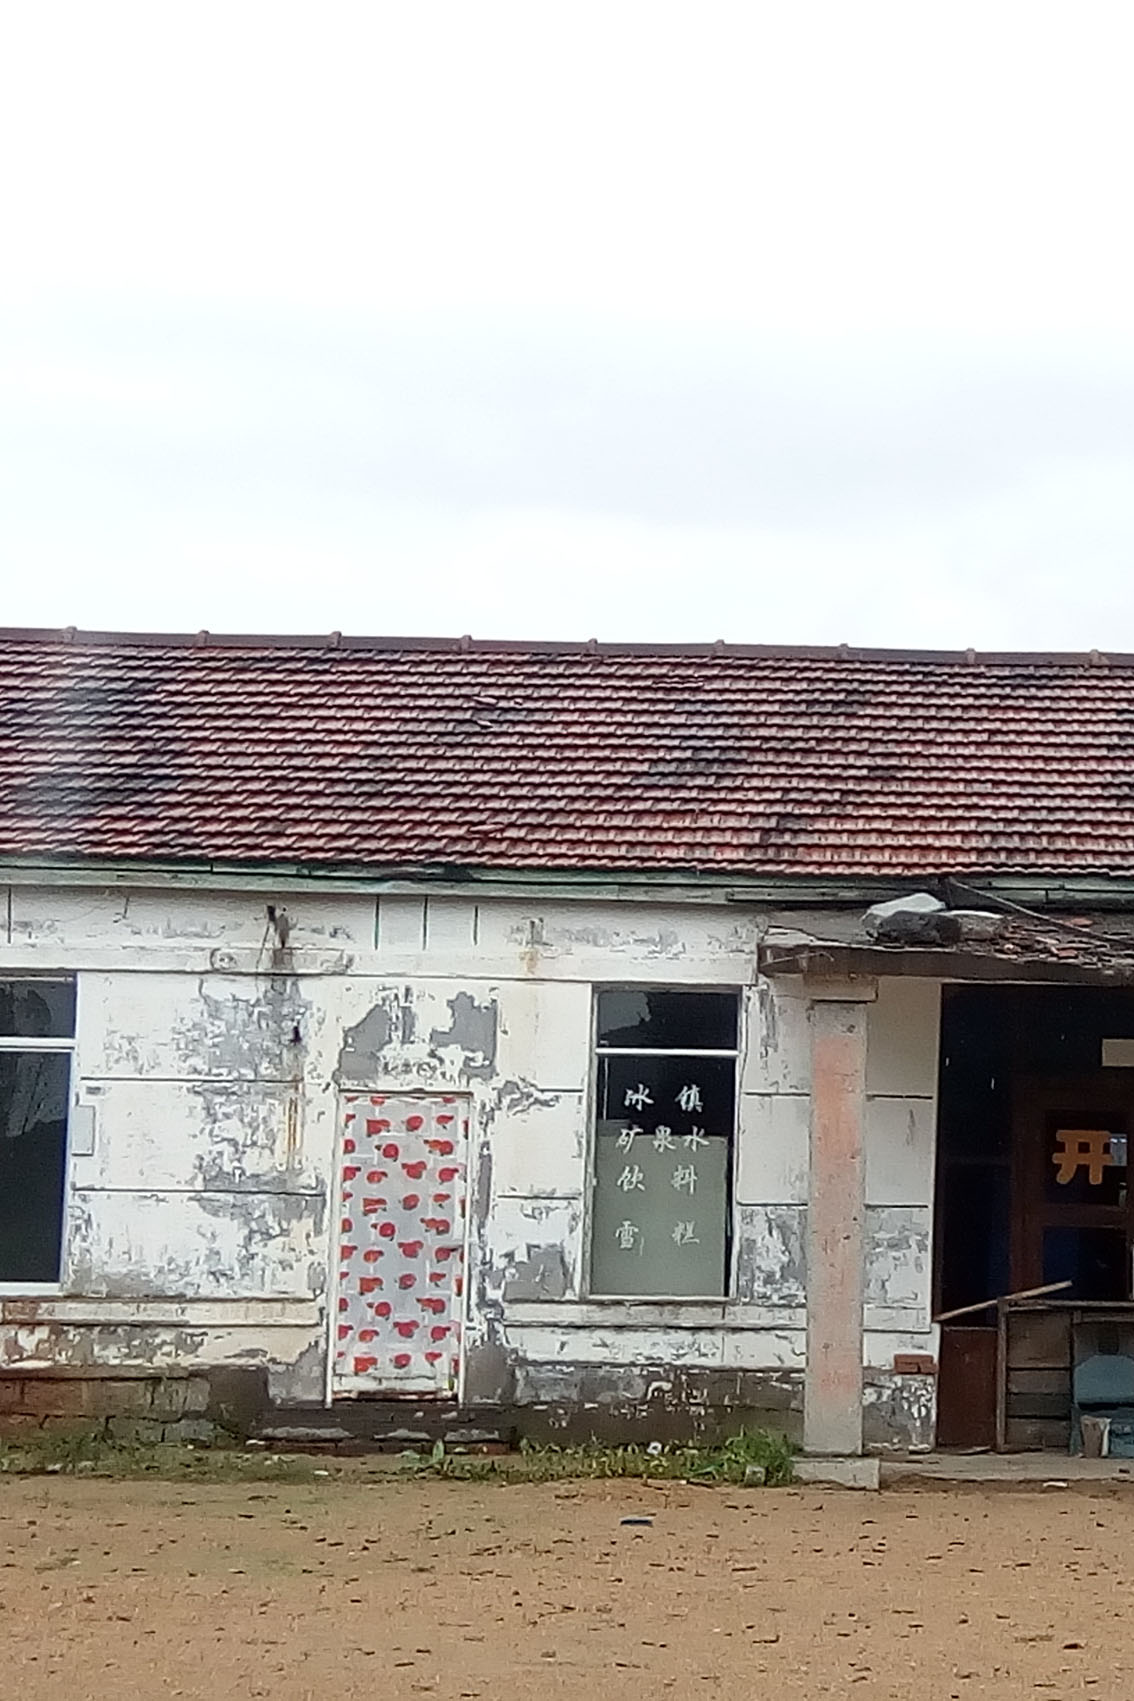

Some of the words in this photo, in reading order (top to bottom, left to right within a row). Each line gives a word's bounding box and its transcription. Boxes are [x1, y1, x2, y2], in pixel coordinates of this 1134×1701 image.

[624, 1083, 704, 1113] 冰镇
[615, 1124, 710, 1154] 矿泉水
[616, 1164, 698, 1195] 饮料
